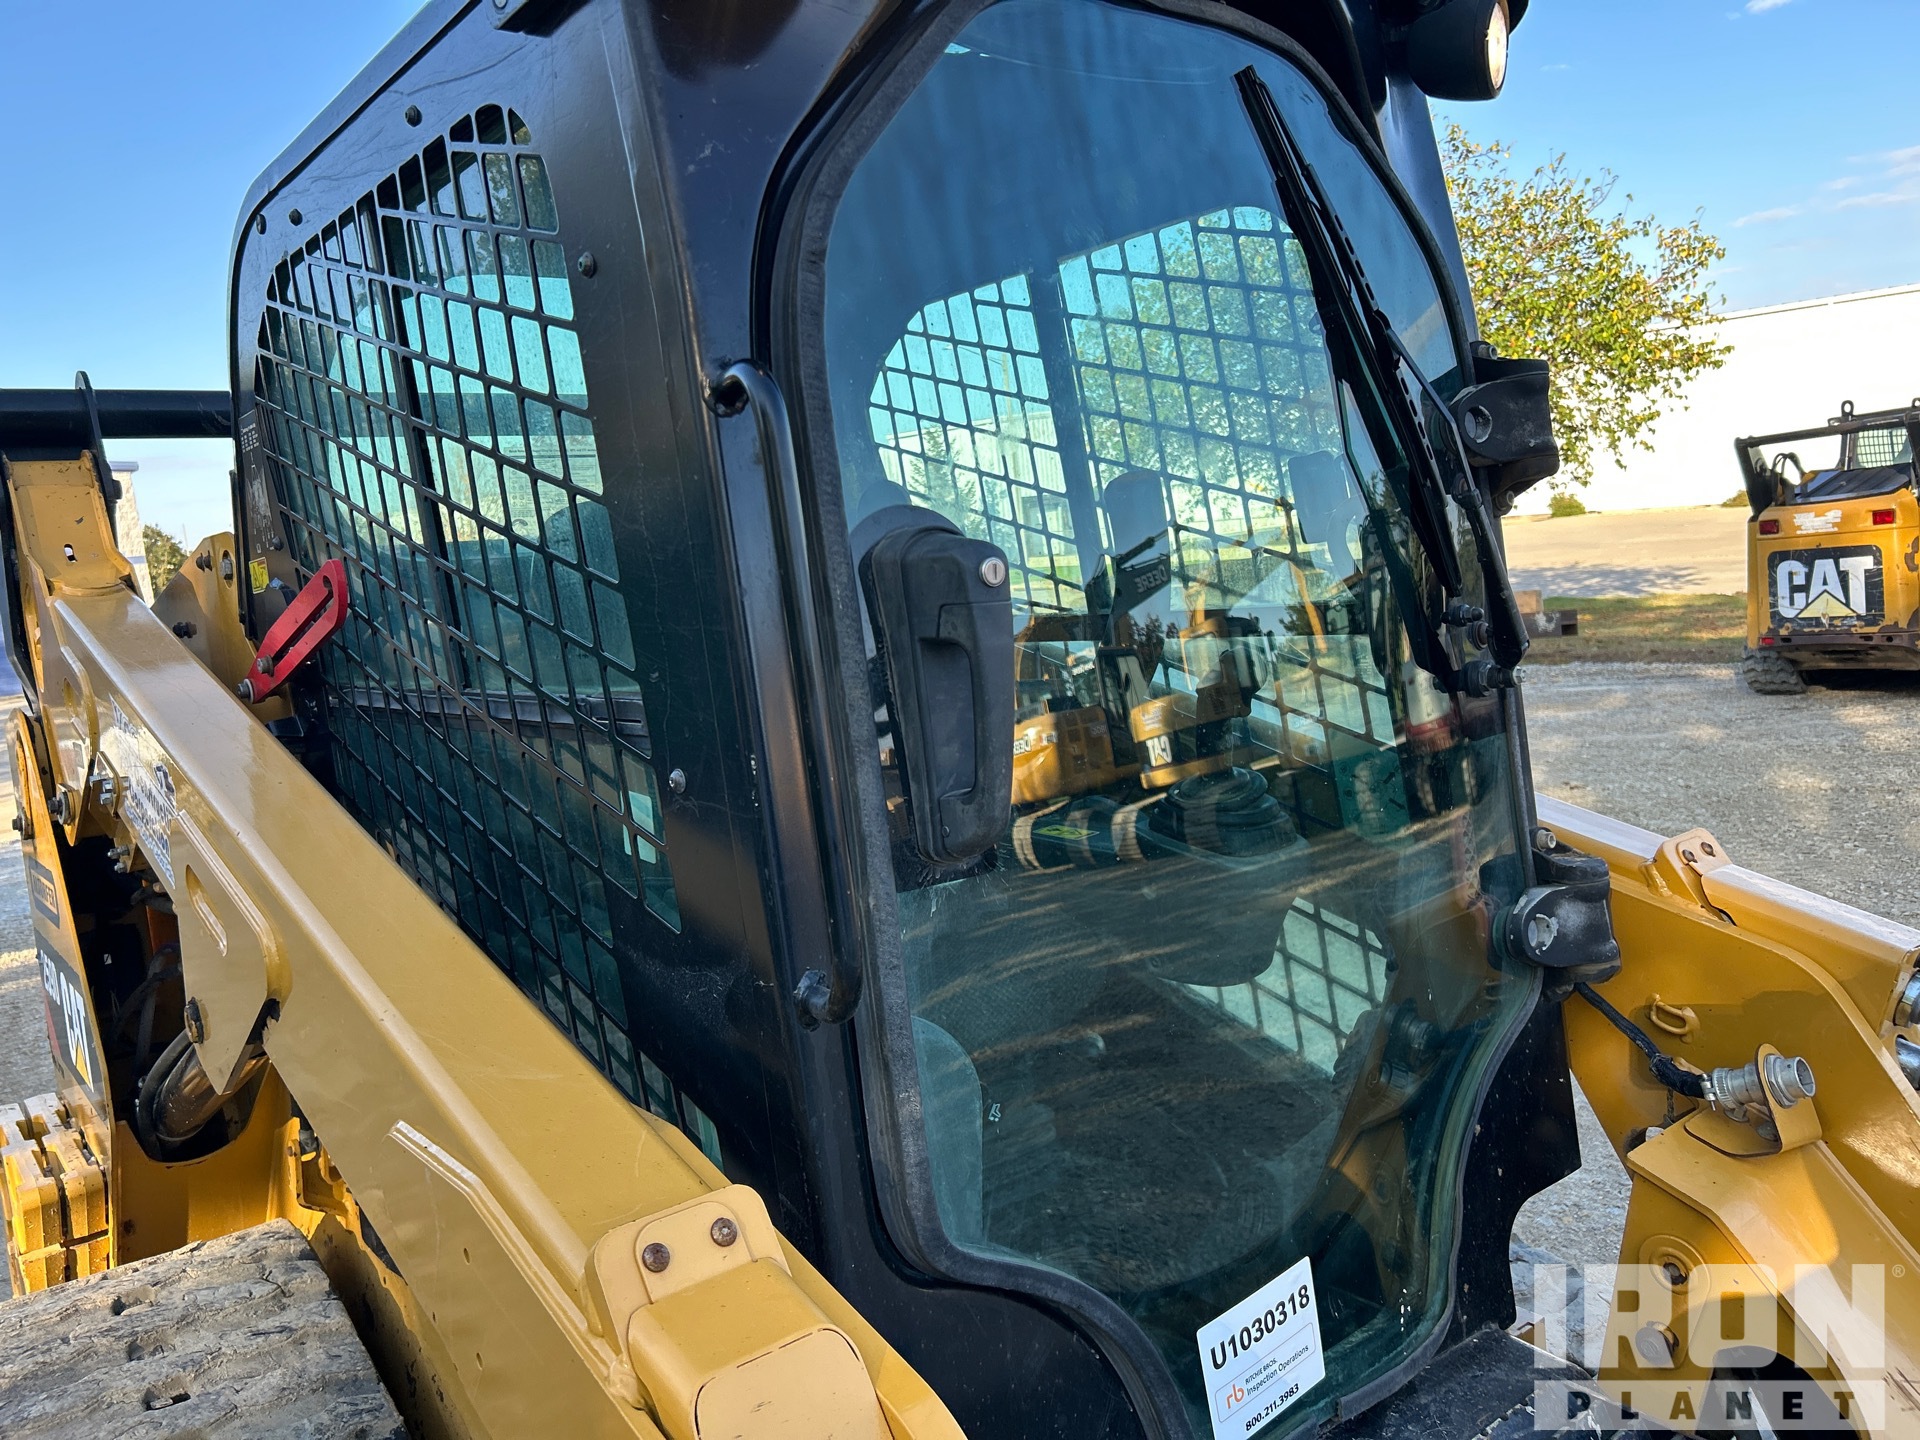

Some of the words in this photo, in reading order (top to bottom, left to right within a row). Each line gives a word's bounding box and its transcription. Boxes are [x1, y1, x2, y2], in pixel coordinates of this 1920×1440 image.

[1776, 555, 1874, 619] CAT
[60, 971, 94, 1093] CAT
[1210, 1284, 1310, 1371] U1030318
[1245, 1367, 1263, 1386] RITCHIE
[1246, 1368, 1278, 1396] Inspection
[1278, 1345, 1309, 1372] Operations
[1245, 1382, 1300, 1432] 800.211.3983
